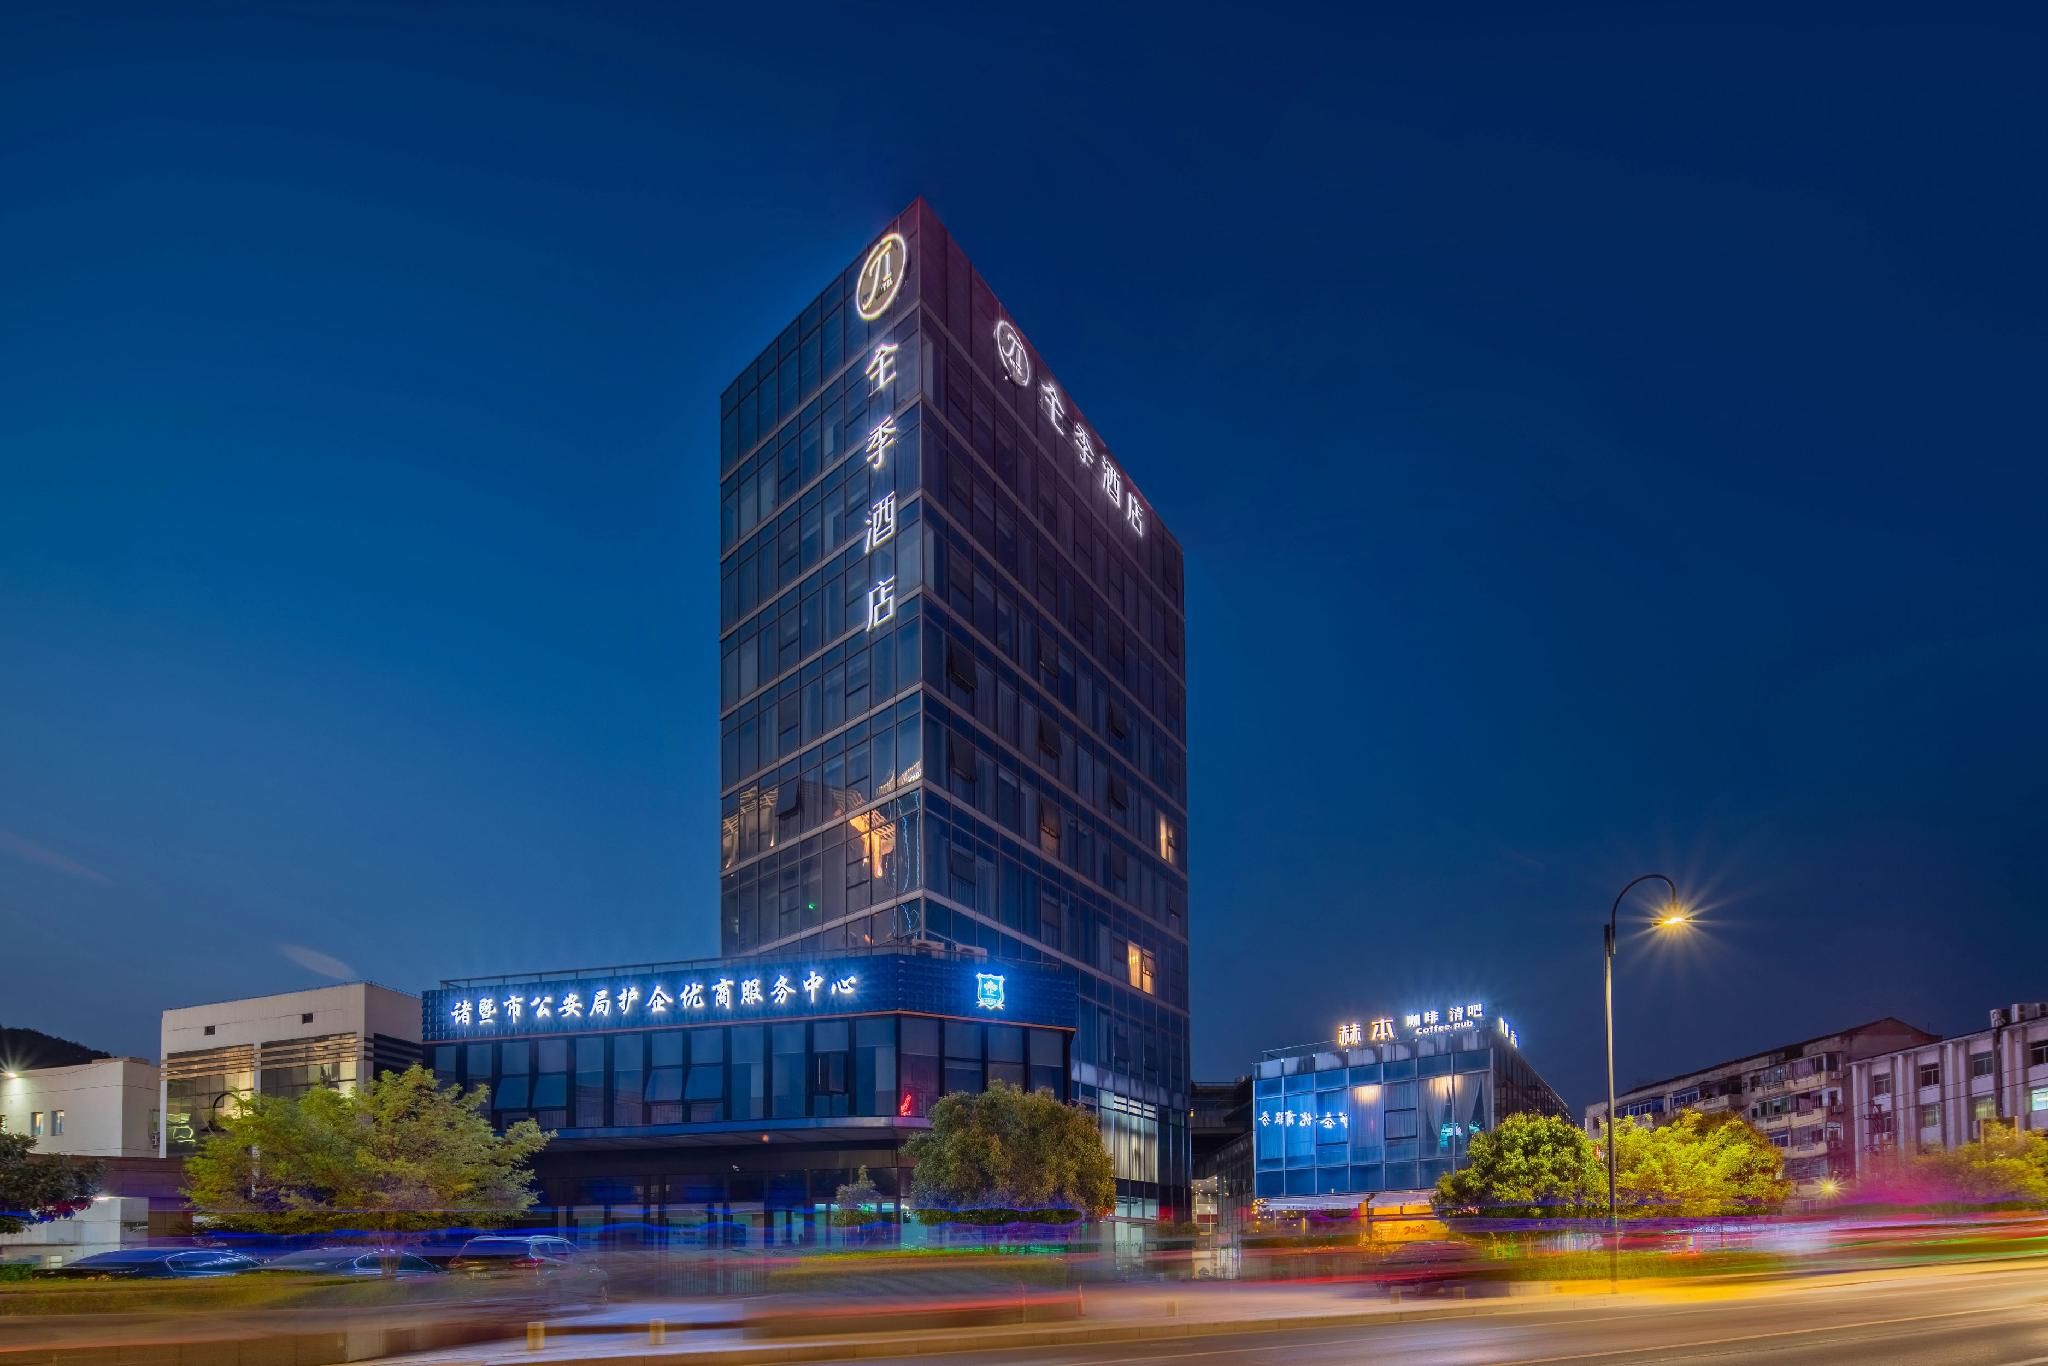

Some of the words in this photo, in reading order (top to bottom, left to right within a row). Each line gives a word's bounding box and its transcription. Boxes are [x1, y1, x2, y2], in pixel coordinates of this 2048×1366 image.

[865, 344, 898, 632] 全季酒店
[1041, 384, 1143, 536] 全季酒店
[451, 970, 858, 1026] 诸暨市公安局护企优商服务中心
[1406, 1010, 1440, 1027] 咖啡
[1338, 1018, 1395, 1046] 赫本
